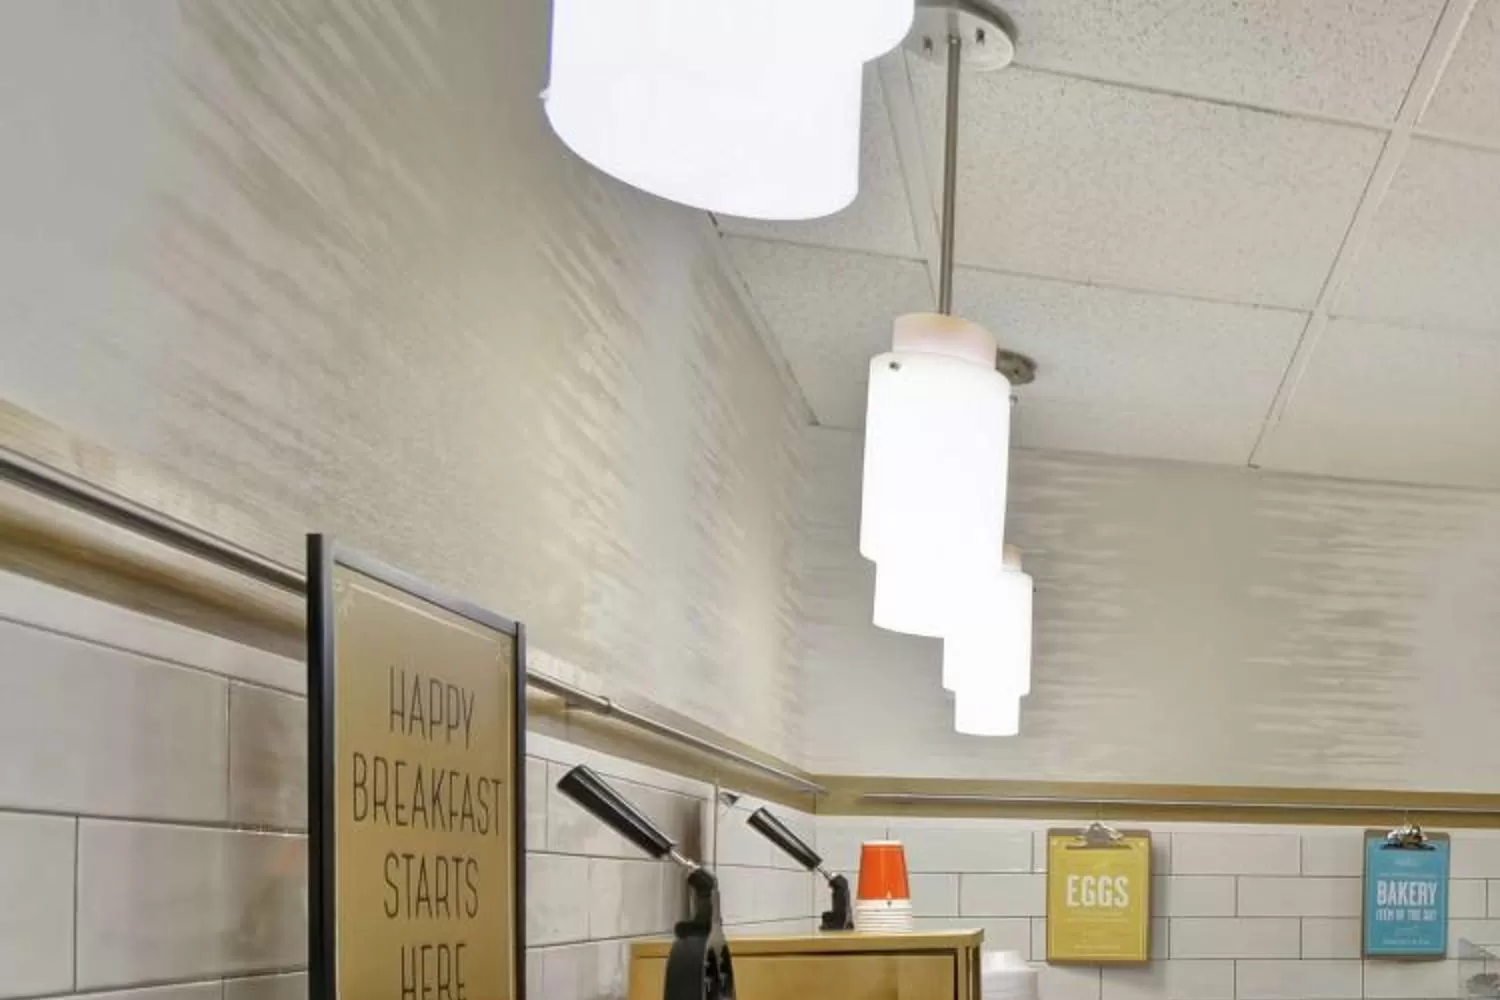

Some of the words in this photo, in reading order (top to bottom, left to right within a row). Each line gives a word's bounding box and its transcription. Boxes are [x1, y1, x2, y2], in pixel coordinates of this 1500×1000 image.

[389, 664, 475, 750] HAPPY
[352, 751, 503, 836] BREAKFAST
[383, 851, 480, 919] STARTS
[1065, 874, 1129, 908] EGGS
[1376, 879, 1438, 907] BAKERY
